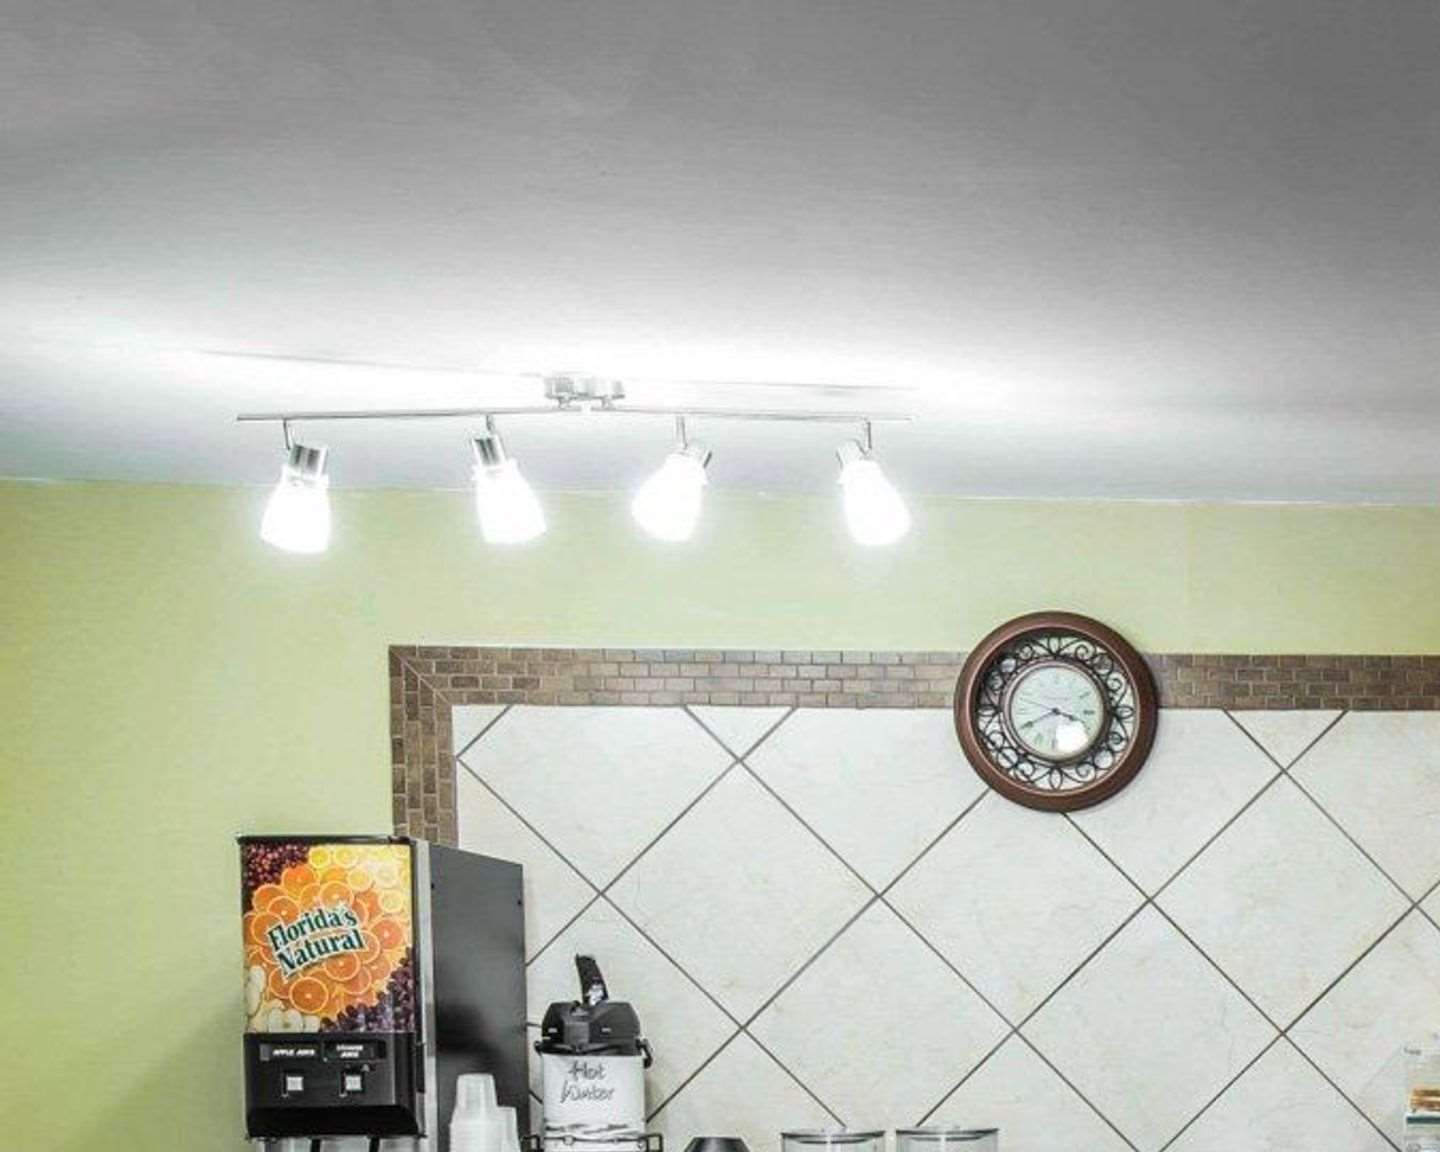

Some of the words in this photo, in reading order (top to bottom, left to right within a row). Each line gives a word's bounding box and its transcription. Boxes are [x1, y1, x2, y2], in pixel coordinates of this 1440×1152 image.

[267, 905, 358, 951] Florida's
[277, 928, 365, 970] Natural
[568, 1060, 606, 1081] Hot
[560, 1080, 615, 1104] Water
